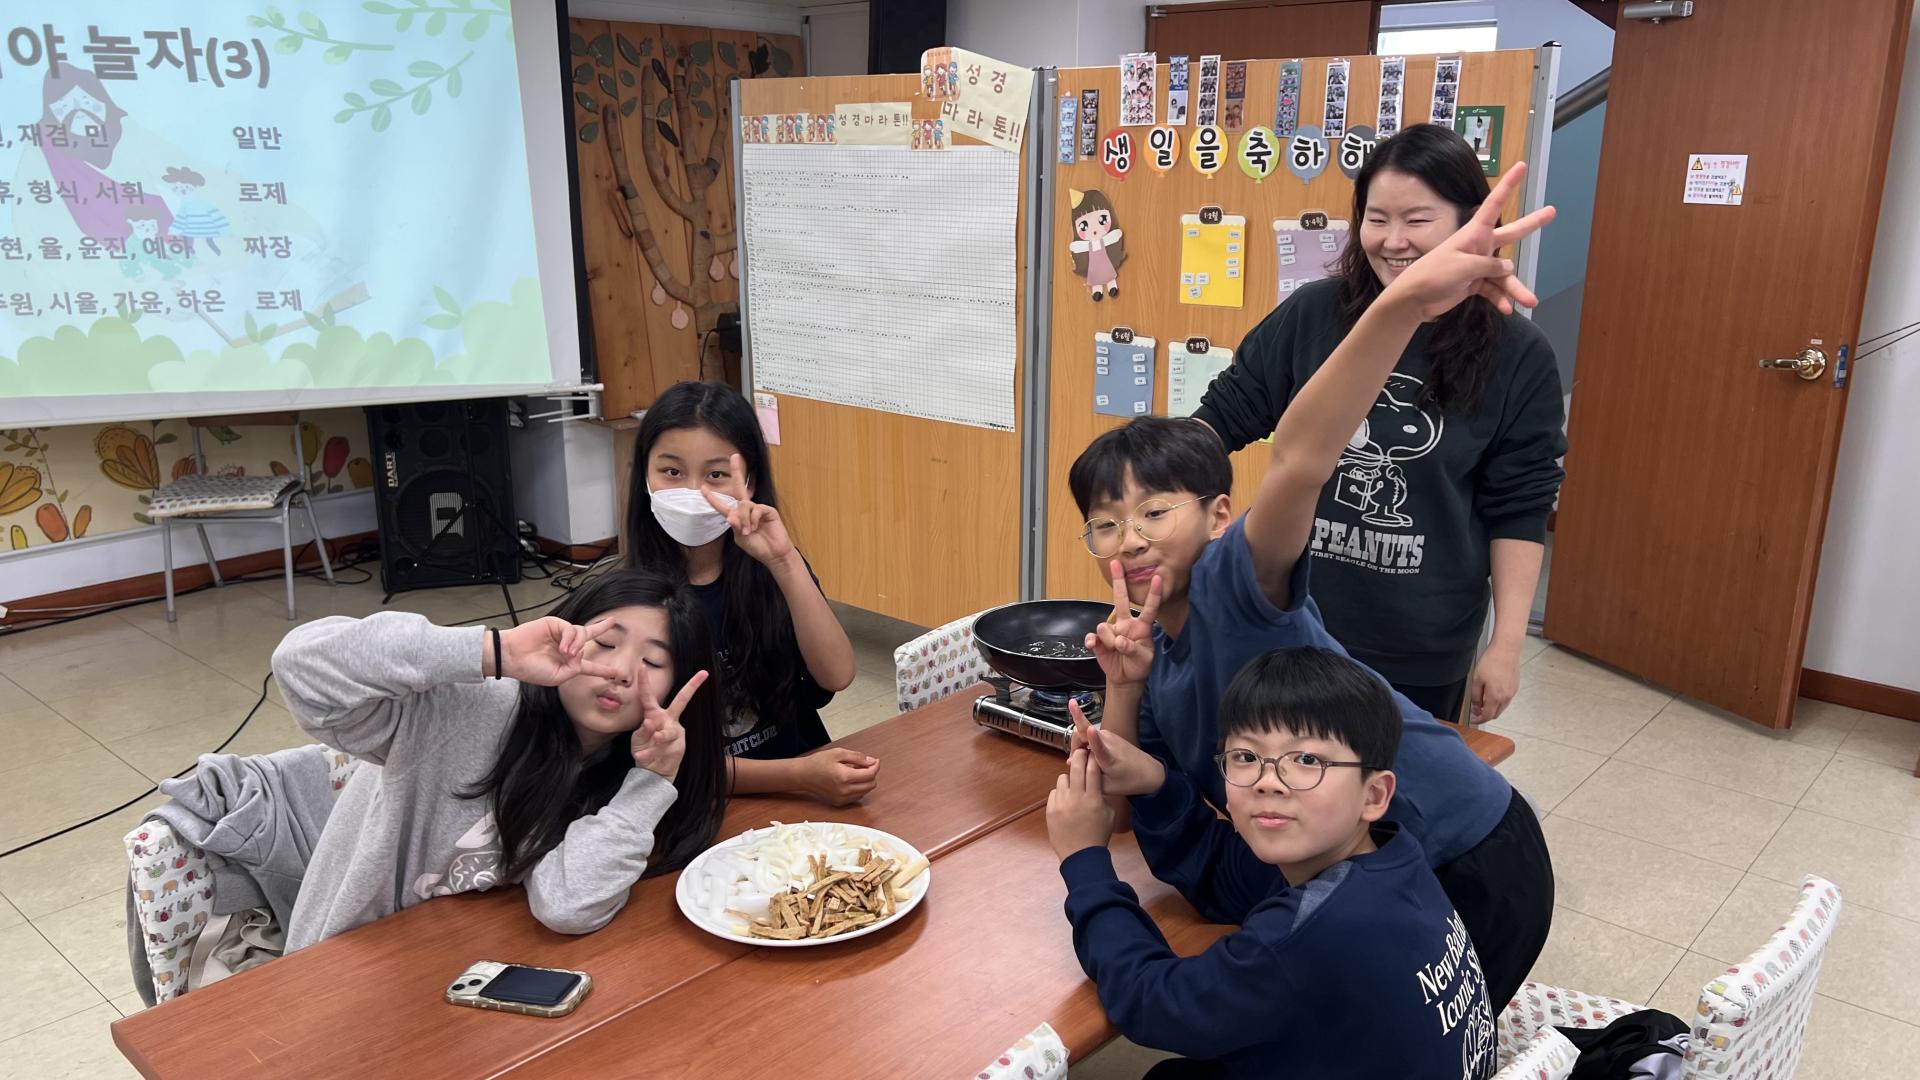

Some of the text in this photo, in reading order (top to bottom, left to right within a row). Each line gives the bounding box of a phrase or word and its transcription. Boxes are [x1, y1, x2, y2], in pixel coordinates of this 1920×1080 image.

[0, 23, 270, 89] 야 놀자(3)
[966, 64, 1007, 94] 성경
[85, 124, 109, 148] 민
[232, 126, 282, 150] 일반
[942, 100, 1021, 144] 마라톤!!
[1105, 129, 1221, 170] 생일을
[27, 179, 88, 205] 형식,
[96, 181, 145, 205] 서휘
[239, 182, 287, 205] 로제
[78, 236, 136, 260] 윤진,
[243, 236, 292, 259] 짜장
[49, 291, 107, 315] 시율,
[112, 291, 171, 315] 가윤,
[177, 290, 225, 313] 하온
[256, 289, 303, 312] 로제
[1311, 517, 1425, 567] PEANUTS
[1310, 550, 1420, 575] FIRST BEAGLE ON THE MOON
[1416, 952, 1455, 1005] New
[1436, 969, 1476, 1036] Iconic
